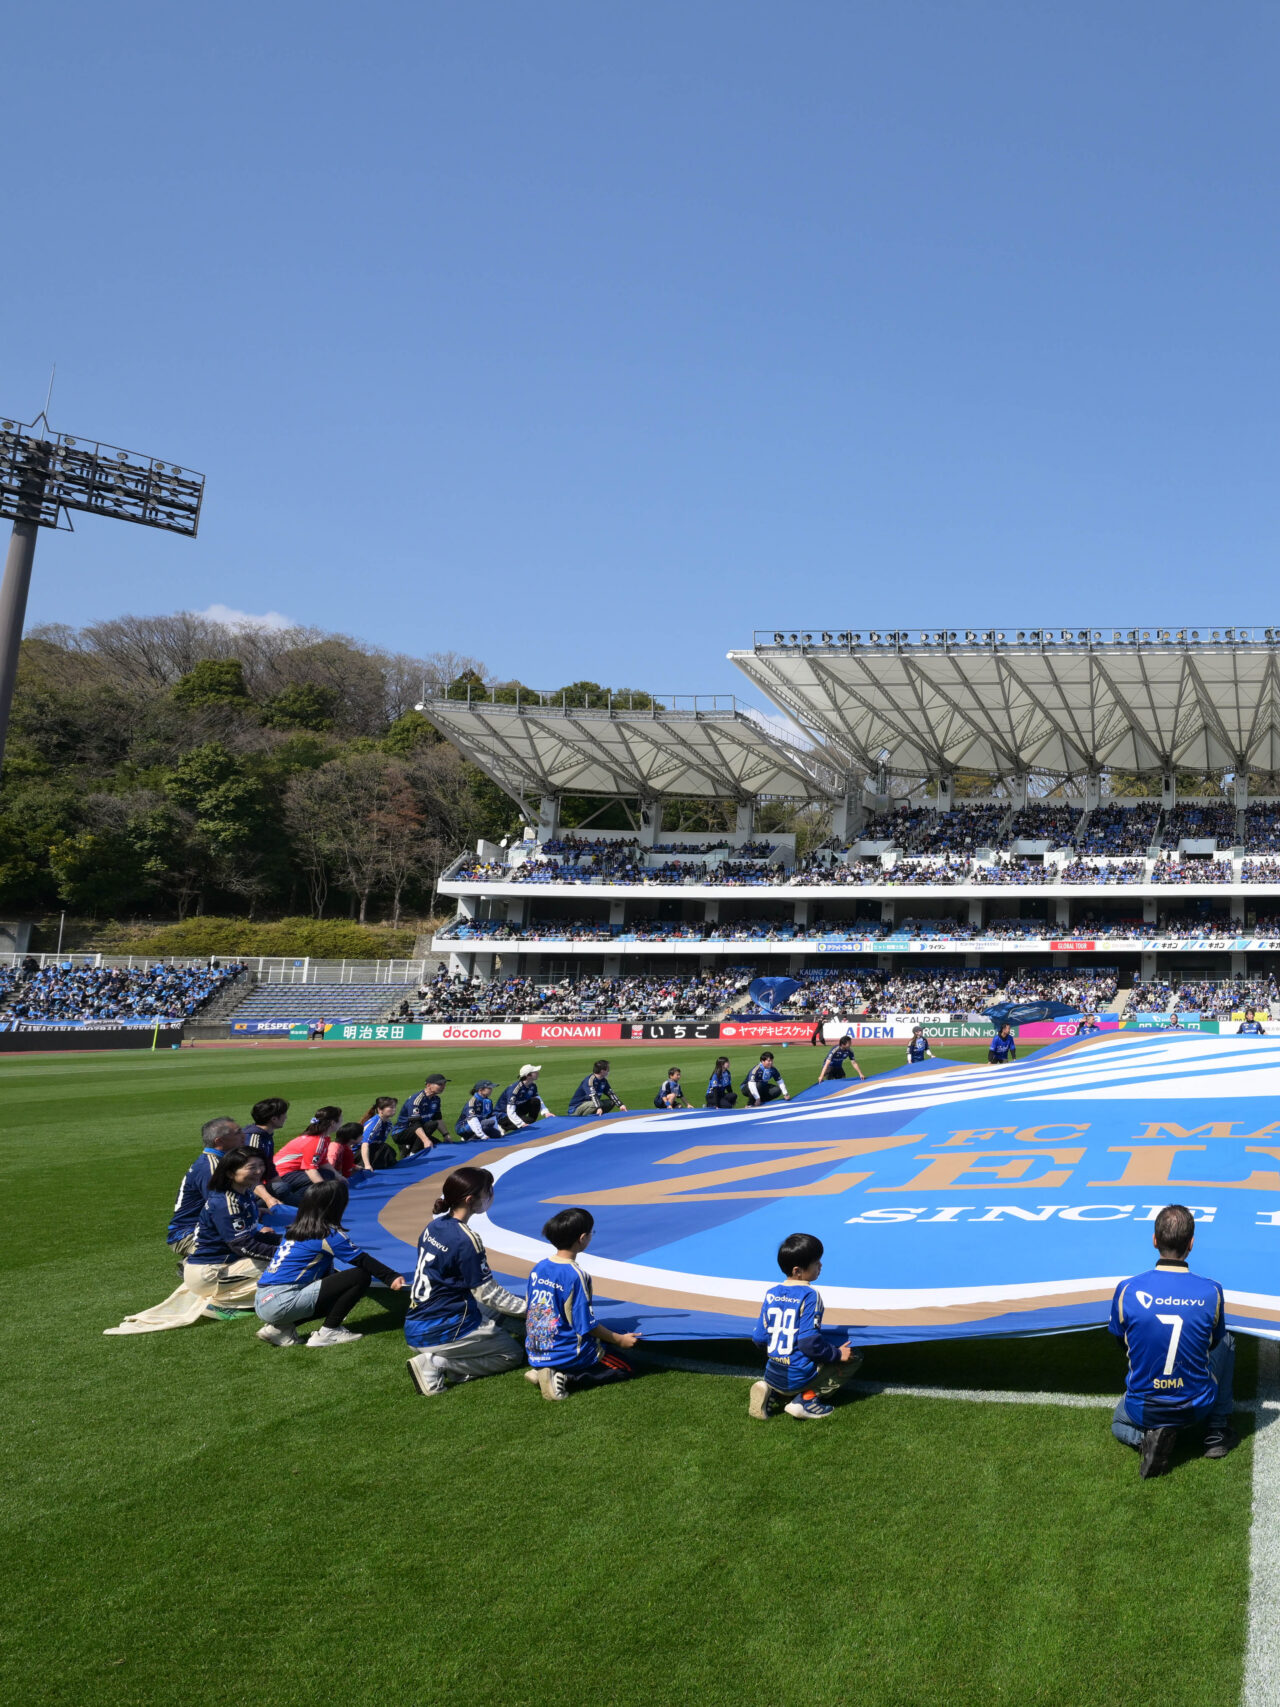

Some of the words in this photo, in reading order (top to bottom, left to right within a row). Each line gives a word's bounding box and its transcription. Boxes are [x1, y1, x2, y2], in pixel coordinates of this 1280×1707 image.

[257, 1022, 302, 1030] RESPE
[343, 1025, 404, 1039] 明治安田
[443, 1026, 501, 1038] docomo
[541, 1026, 601, 1038] KONAMI
[650, 1024, 710, 1039] いちご
[738, 1025, 814, 1036] ヤマザキビスケット
[922, 1027, 958, 1037] ROUTE
[983, 1029, 1015, 1037] HOS
[931, 1122, 1091, 1148] FC
[844, 1203, 1218, 1226] SINCE
[410, 1246, 437, 1302] 16
[531, 1288, 554, 1306] 202
[1154, 1296, 1205, 1307] odakyu
[1155, 1313, 1184, 1376] 7
[1153, 1377, 1184, 1390] SOMA
